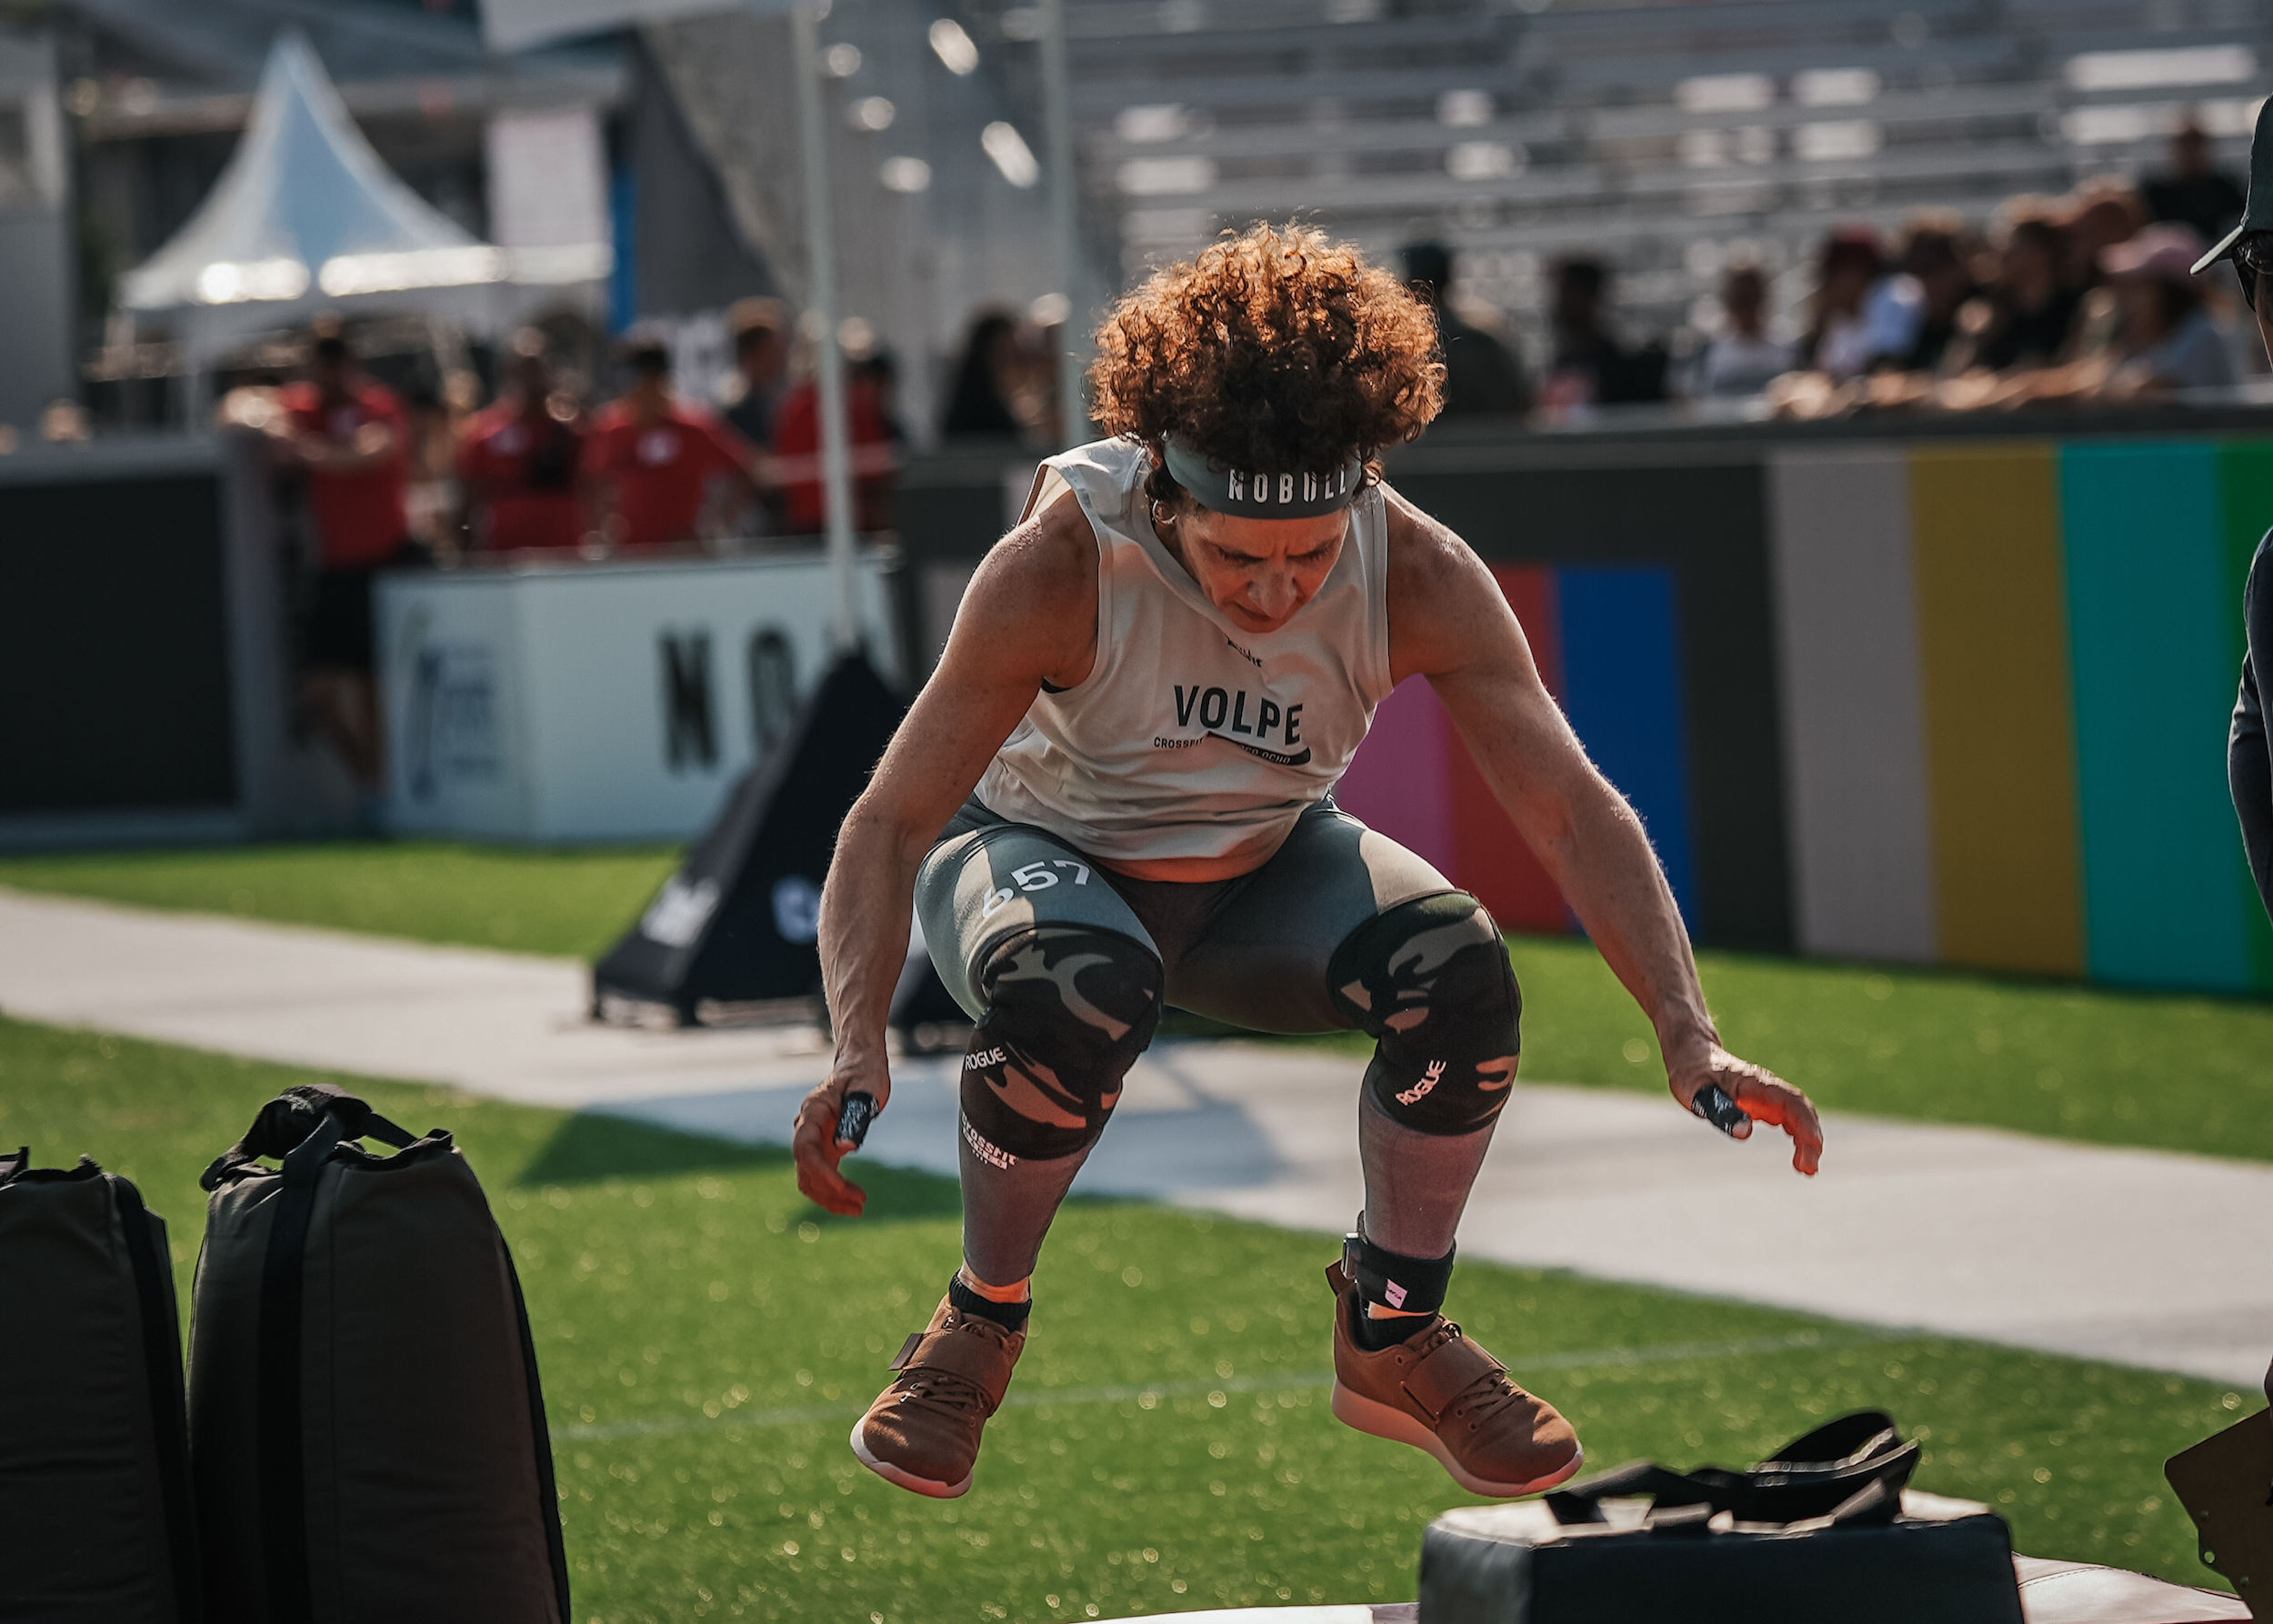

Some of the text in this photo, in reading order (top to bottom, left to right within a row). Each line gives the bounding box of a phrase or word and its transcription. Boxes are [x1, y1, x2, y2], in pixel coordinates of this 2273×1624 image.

[1228, 463, 1347, 504] NOBULL
[1174, 685, 1304, 746] VOLPE
[982, 859, 1090, 917] 657
[965, 1047, 1007, 1071] ROGUE
[1395, 1059, 1447, 1106] ROGUE
